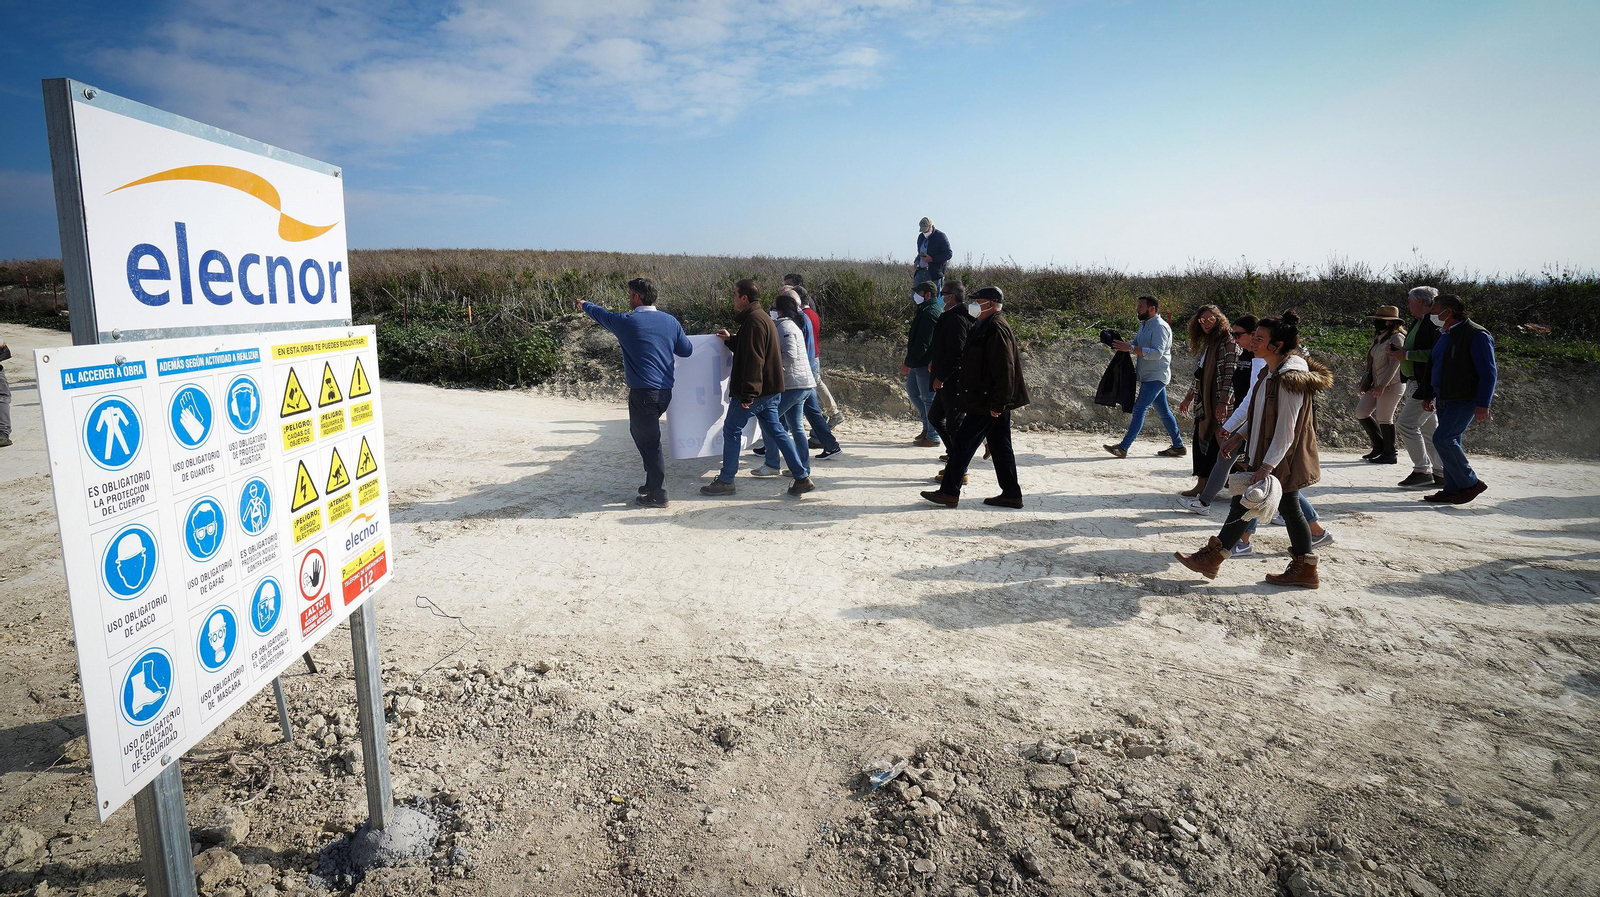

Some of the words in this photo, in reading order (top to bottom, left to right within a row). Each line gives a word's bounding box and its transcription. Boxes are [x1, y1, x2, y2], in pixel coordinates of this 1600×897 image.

[126, 221, 342, 306] elecnor
[278, 348, 286, 356] EN
[286, 346, 300, 354] ESTA
[301, 345, 314, 353] OBRA
[322, 341, 339, 350] PUEDES
[159, 358, 184, 372] ADEMÁS
[185, 356, 204, 369] SEGÚN
[205, 354, 231, 366] ACTIVIDAD
[233, 353, 236, 362] A
[237, 351, 259, 361] REALIZAR
[64, 373, 76, 384] AL
[78, 368, 115, 383] ACCEDER
[117, 367, 122, 377] A
[123, 364, 144, 376] OBRA
[228, 442, 238, 452] USO
[239, 433, 267, 447] OBLIGATORIO
[290, 436, 310, 447] OBJETOS
[173, 461, 184, 472] USO
[185, 450, 220, 468] OBLIGATORIO
[232, 451, 238, 460] DE
[88, 486, 99, 498] ES
[102, 470, 150, 494] OBLIGATORIO
[182, 472, 189, 482] DE
[190, 464, 215, 479] GUANTES
[94, 499, 104, 508] LA
[107, 483, 149, 504] PROTECCION
[102, 505, 117, 516] DEL
[119, 495, 145, 510] CUERPO
[296, 524, 321, 542] ELECTRICO
[300, 520, 316, 533] RIESGO
[345, 521, 379, 551] elecnor
[240, 549, 247, 559] ES
[248, 533, 278, 555] OBLIGATORIO
[187, 577, 199, 590] USO
[200, 559, 233, 583] OBLIGATORIO
[247, 560, 262, 573] CONTRA
[200, 584, 208, 595] DE
[209, 575, 225, 591] GAFAS
[360, 570, 373, 591] 112
[107, 618, 123, 633] USO
[124, 594, 168, 624] OBLIGATORIO
[124, 626, 134, 638] DE
[136, 613, 156, 632] CASCO
[252, 651, 258, 661] ES
[258, 628, 288, 655] OBLIGATORIO
[258, 654, 267, 664] USO
[260, 649, 284, 672] PROTECTORA
[200, 689, 212, 704] USO
[213, 664, 244, 695] OBLIGATORIO
[207, 699, 215, 710] DE
[217, 679, 242, 703] MASCARA
[124, 738, 138, 755] USO
[140, 706, 180, 743] OBLIGATORIO
[135, 745, 143, 759] DE
[145, 723, 173, 750] CALZADO
[132, 759, 141, 773] DE
[142, 730, 178, 764] SEGURIDAD
